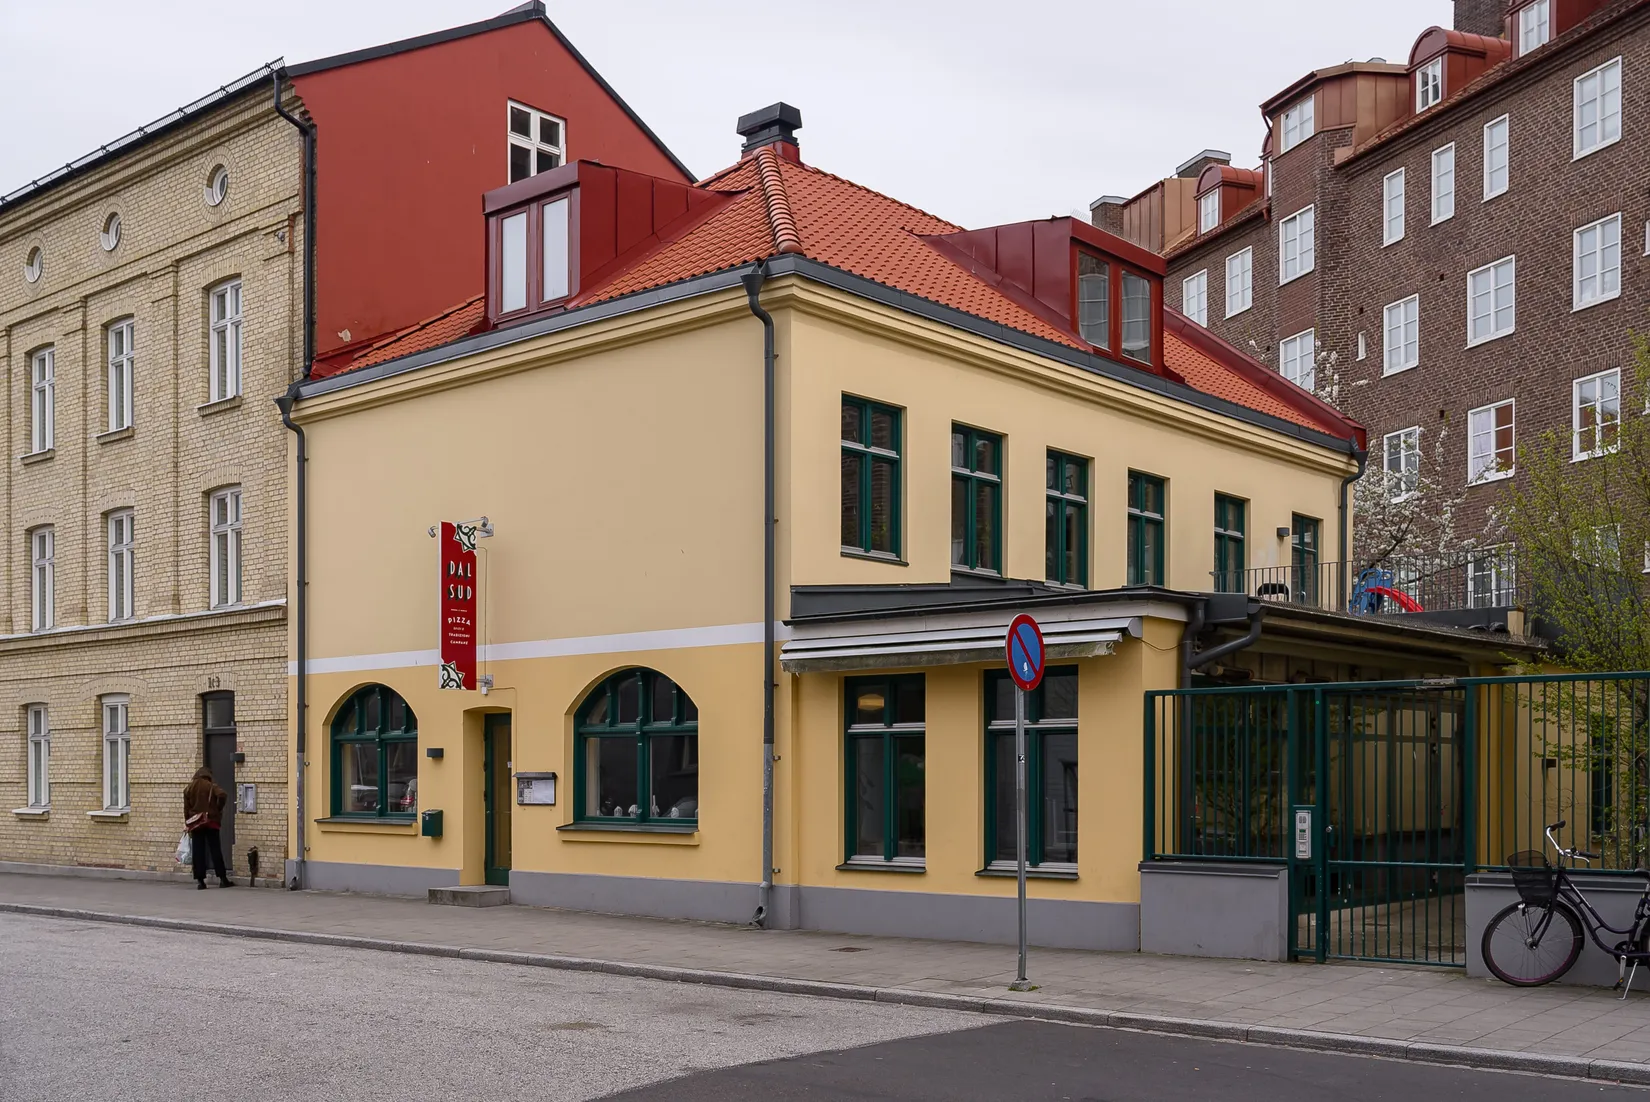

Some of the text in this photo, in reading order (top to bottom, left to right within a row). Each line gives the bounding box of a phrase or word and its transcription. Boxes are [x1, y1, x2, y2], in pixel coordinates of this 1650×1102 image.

[449, 560, 472, 577] DAL
[449, 584, 472, 600] SUD
[447, 616, 471, 625] PIZZA
